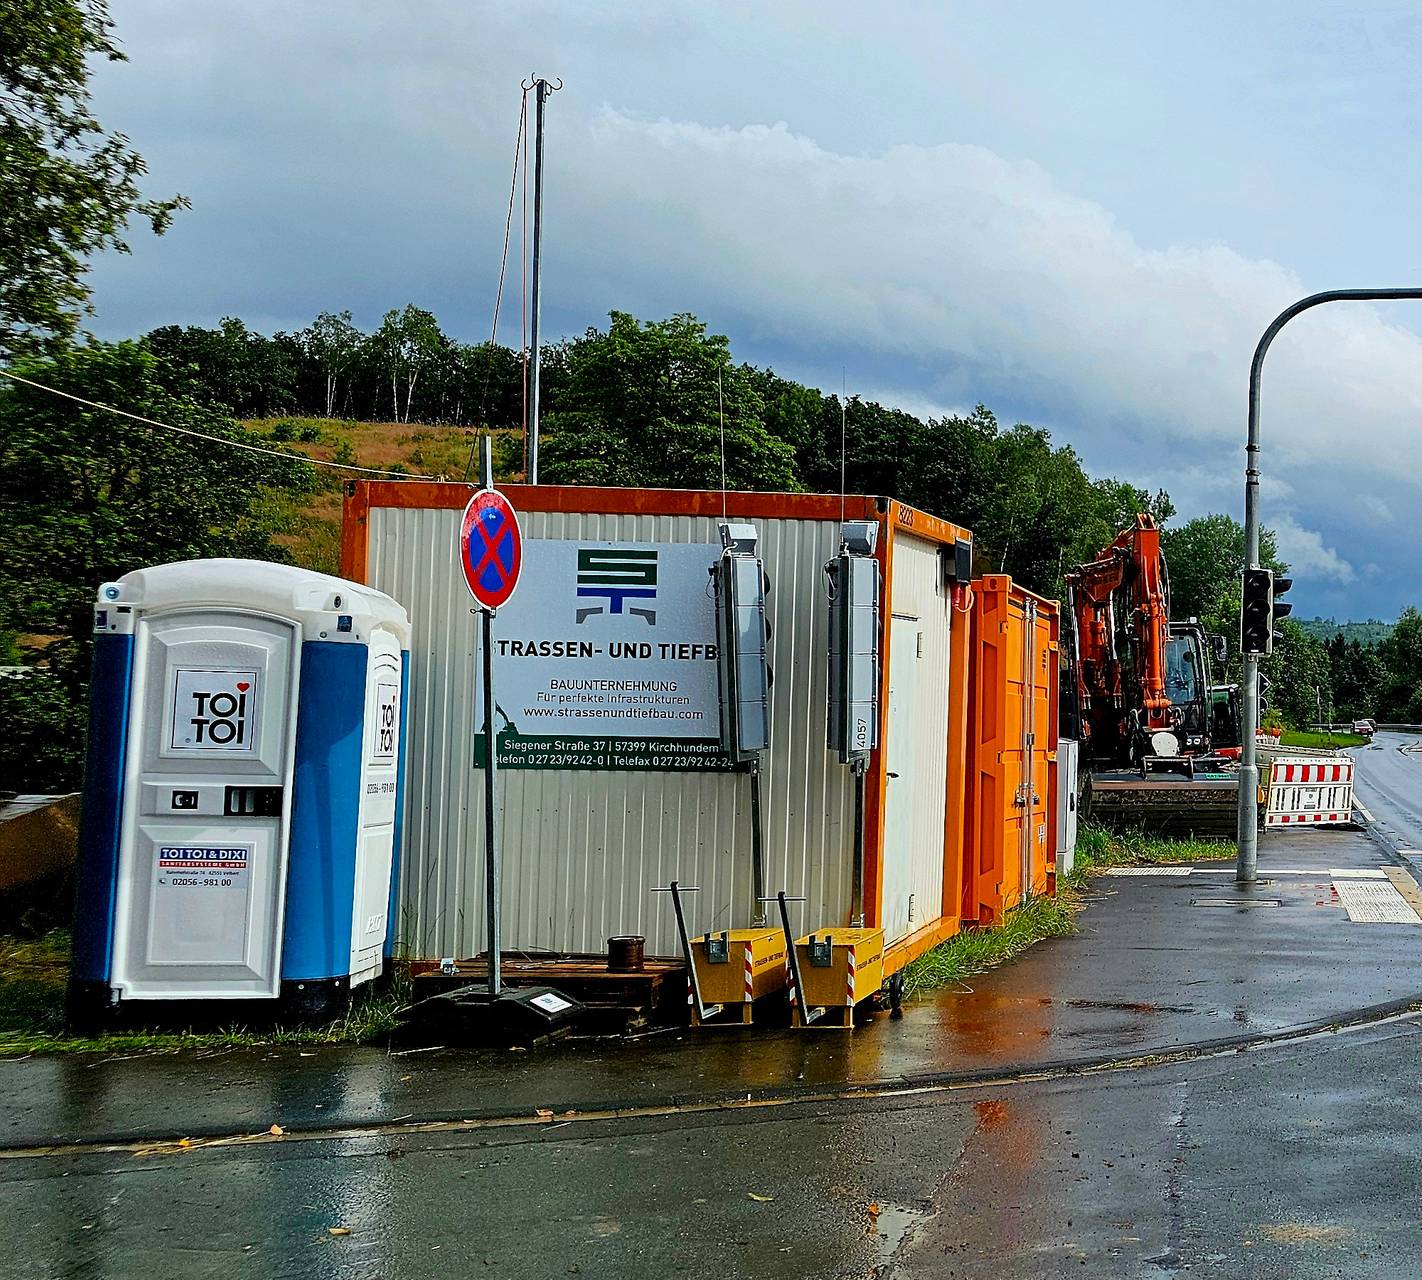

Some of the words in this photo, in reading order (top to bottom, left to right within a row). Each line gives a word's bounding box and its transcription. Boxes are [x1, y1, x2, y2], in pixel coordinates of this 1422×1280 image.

[494, 640, 603, 658] TRASSEN-
[608, 642, 652, 659] UND
[657, 643, 719, 660] TIEFB
[550, 679, 678, 692] BAUUNTERNEHMUNG
[192, 691, 247, 718] TOI
[536, 692, 556, 702] Für
[558, 693, 604, 704] perfekte
[607, 693, 690, 705] Infrastrukturen
[381, 704, 395, 728] TOI
[523, 706, 704, 720] www.strassenundtiefbau.com
[190, 718, 245, 745] TOI
[856, 718, 867, 748] 4057
[379, 728, 394, 752] TOI
[504, 739, 552, 752] Siegener
[554, 740, 590, 751] Straße
[592, 741, 606, 751] 37
[615, 741, 647, 752] 57399
[648, 742, 719, 753] Kirchhundem
[495, 754, 525, 765] elefon
[613, 755, 650, 766] Telefax
[162, 849, 184, 859] TOI
[185, 849, 208, 859] TOI
[208, 850, 217, 859] &
[219, 850, 246, 860] DIXI
[221, 879, 232, 887] 00
